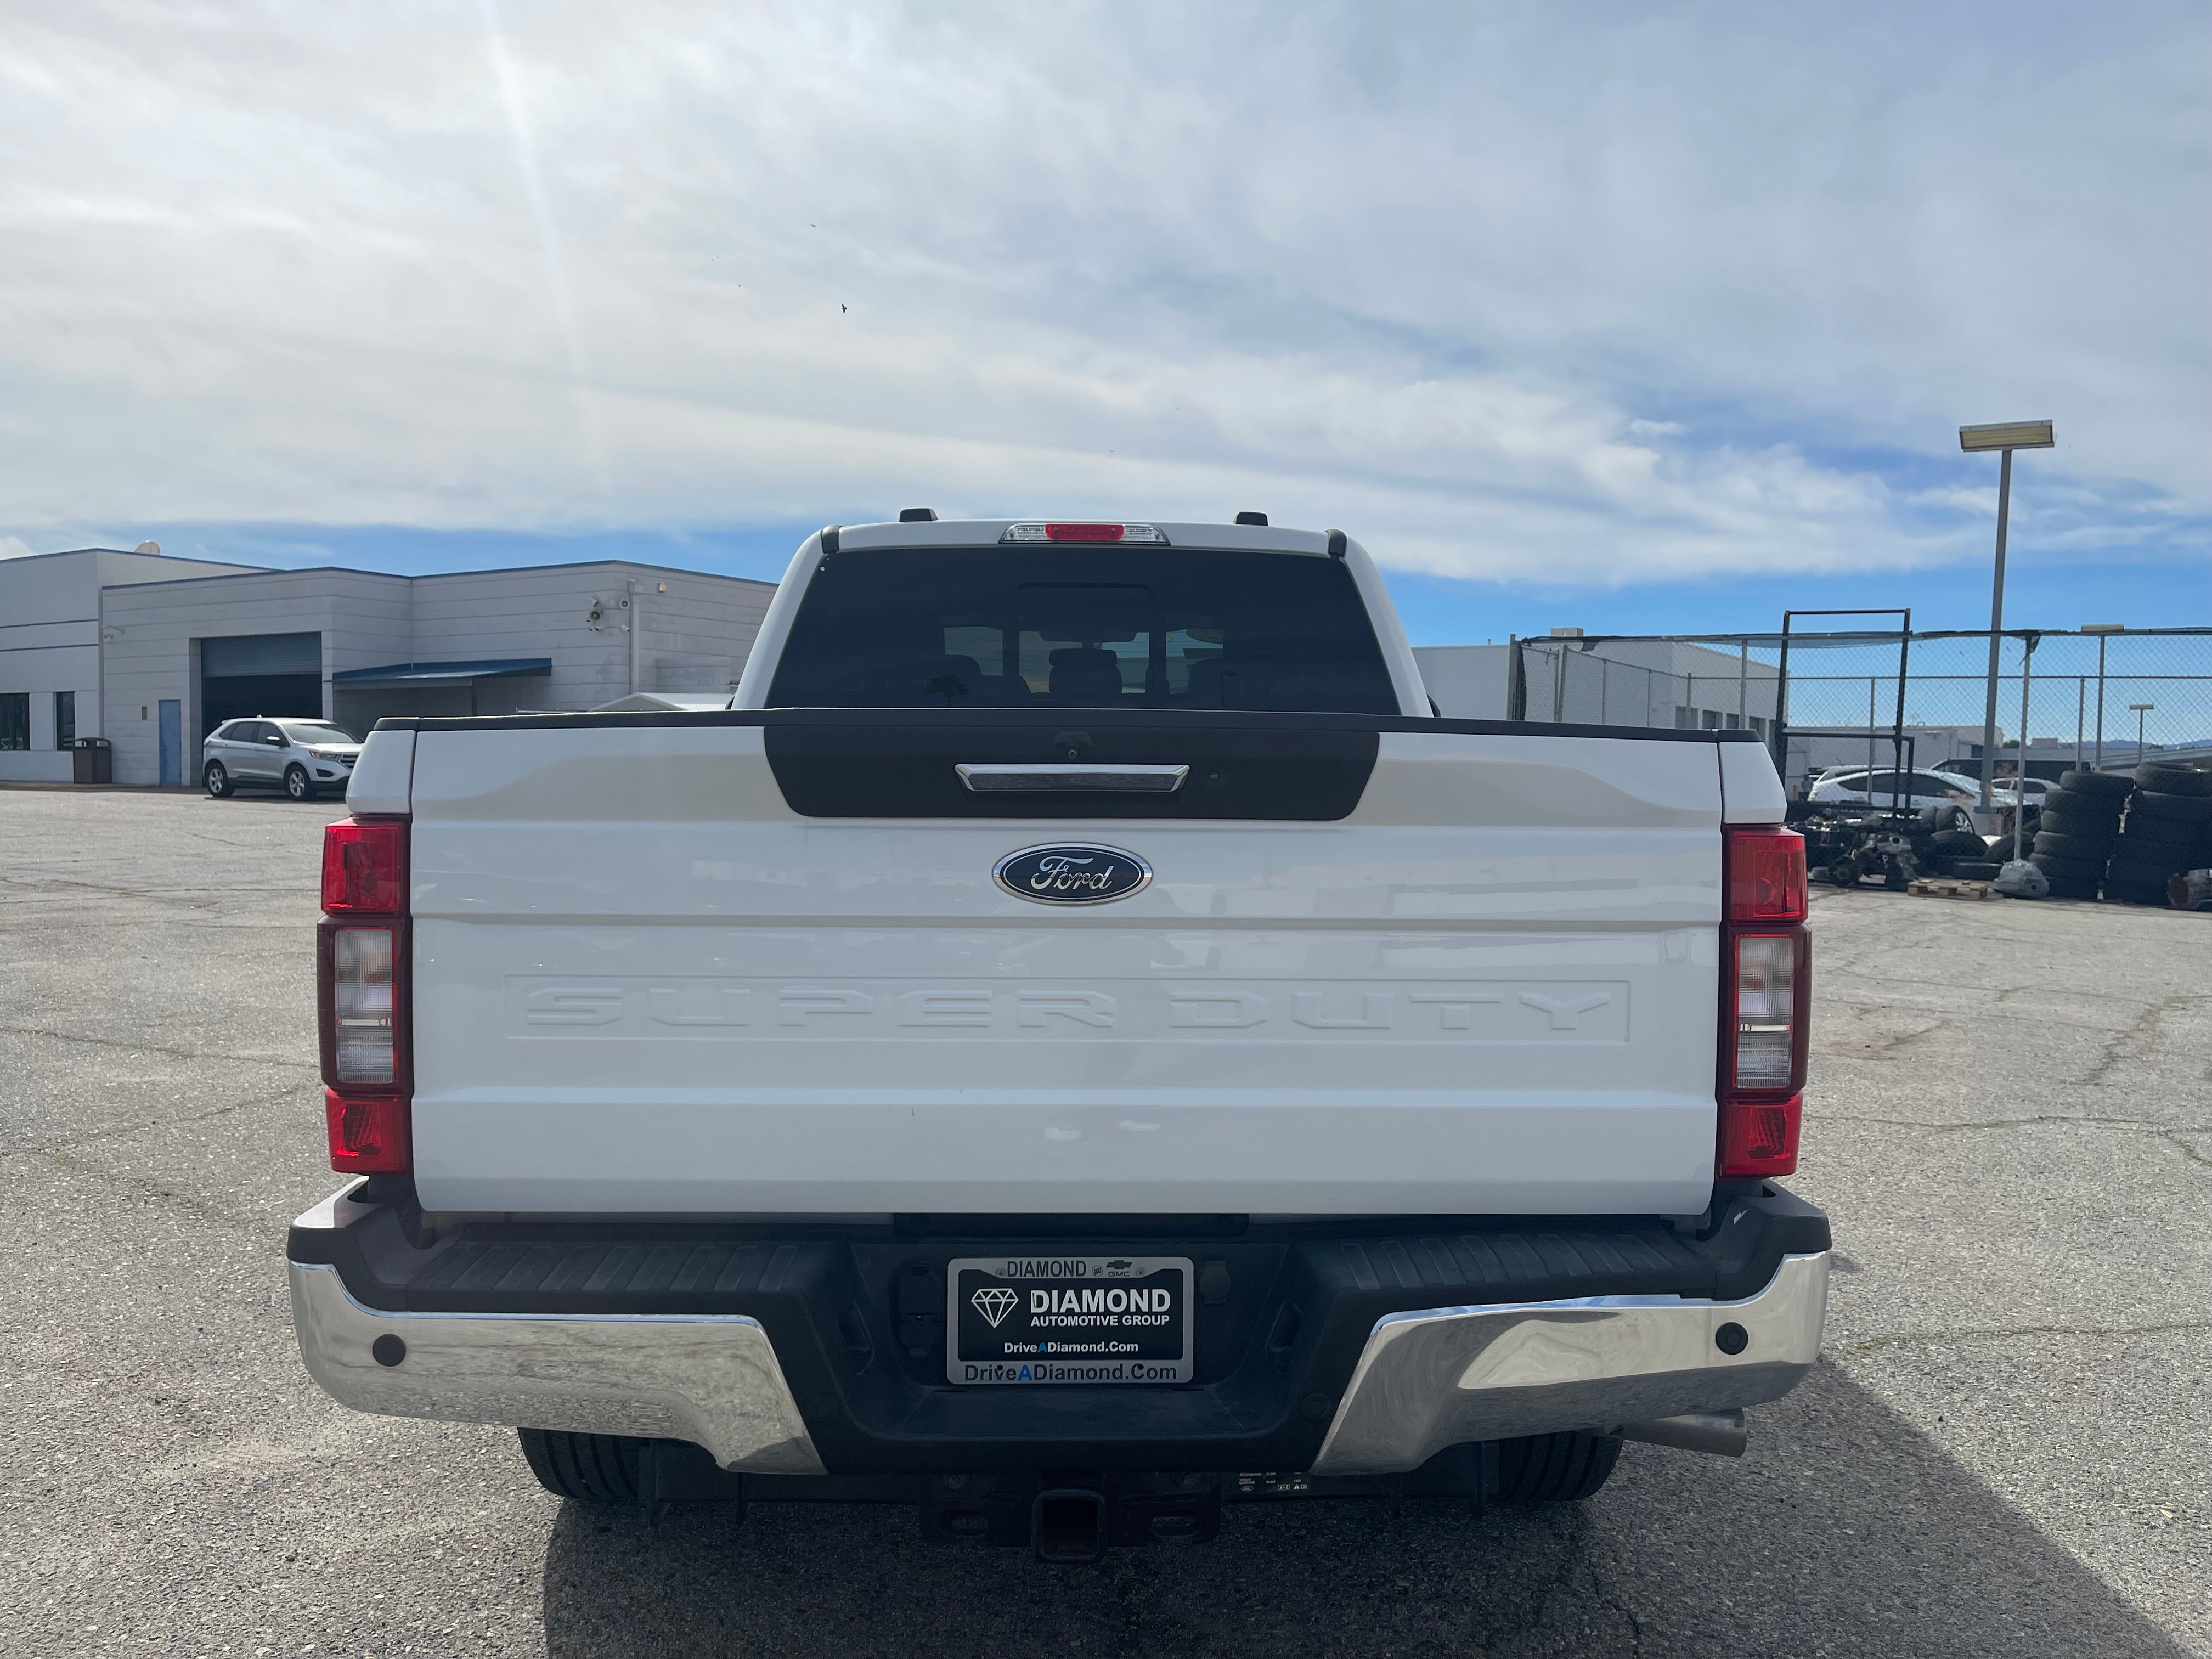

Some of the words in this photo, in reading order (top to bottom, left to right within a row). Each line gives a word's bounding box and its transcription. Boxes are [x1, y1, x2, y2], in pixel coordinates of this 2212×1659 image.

[1030, 856, 1114, 890] Ford
[526, 987, 1118, 1029] SUPER
[1169, 990, 1612, 1030] DUTY
[1007, 1260, 1087, 1277] DIAMOND
[1030, 1289, 1171, 1314] DIAMOND
[1030, 1316, 1118, 1328] AUTOMOTIVE
[1122, 1315, 1170, 1326] GROUP
[1004, 1341, 1139, 1353] DriveADiamond.Com
[964, 1364, 1177, 1381] DriveADiamond.Com
